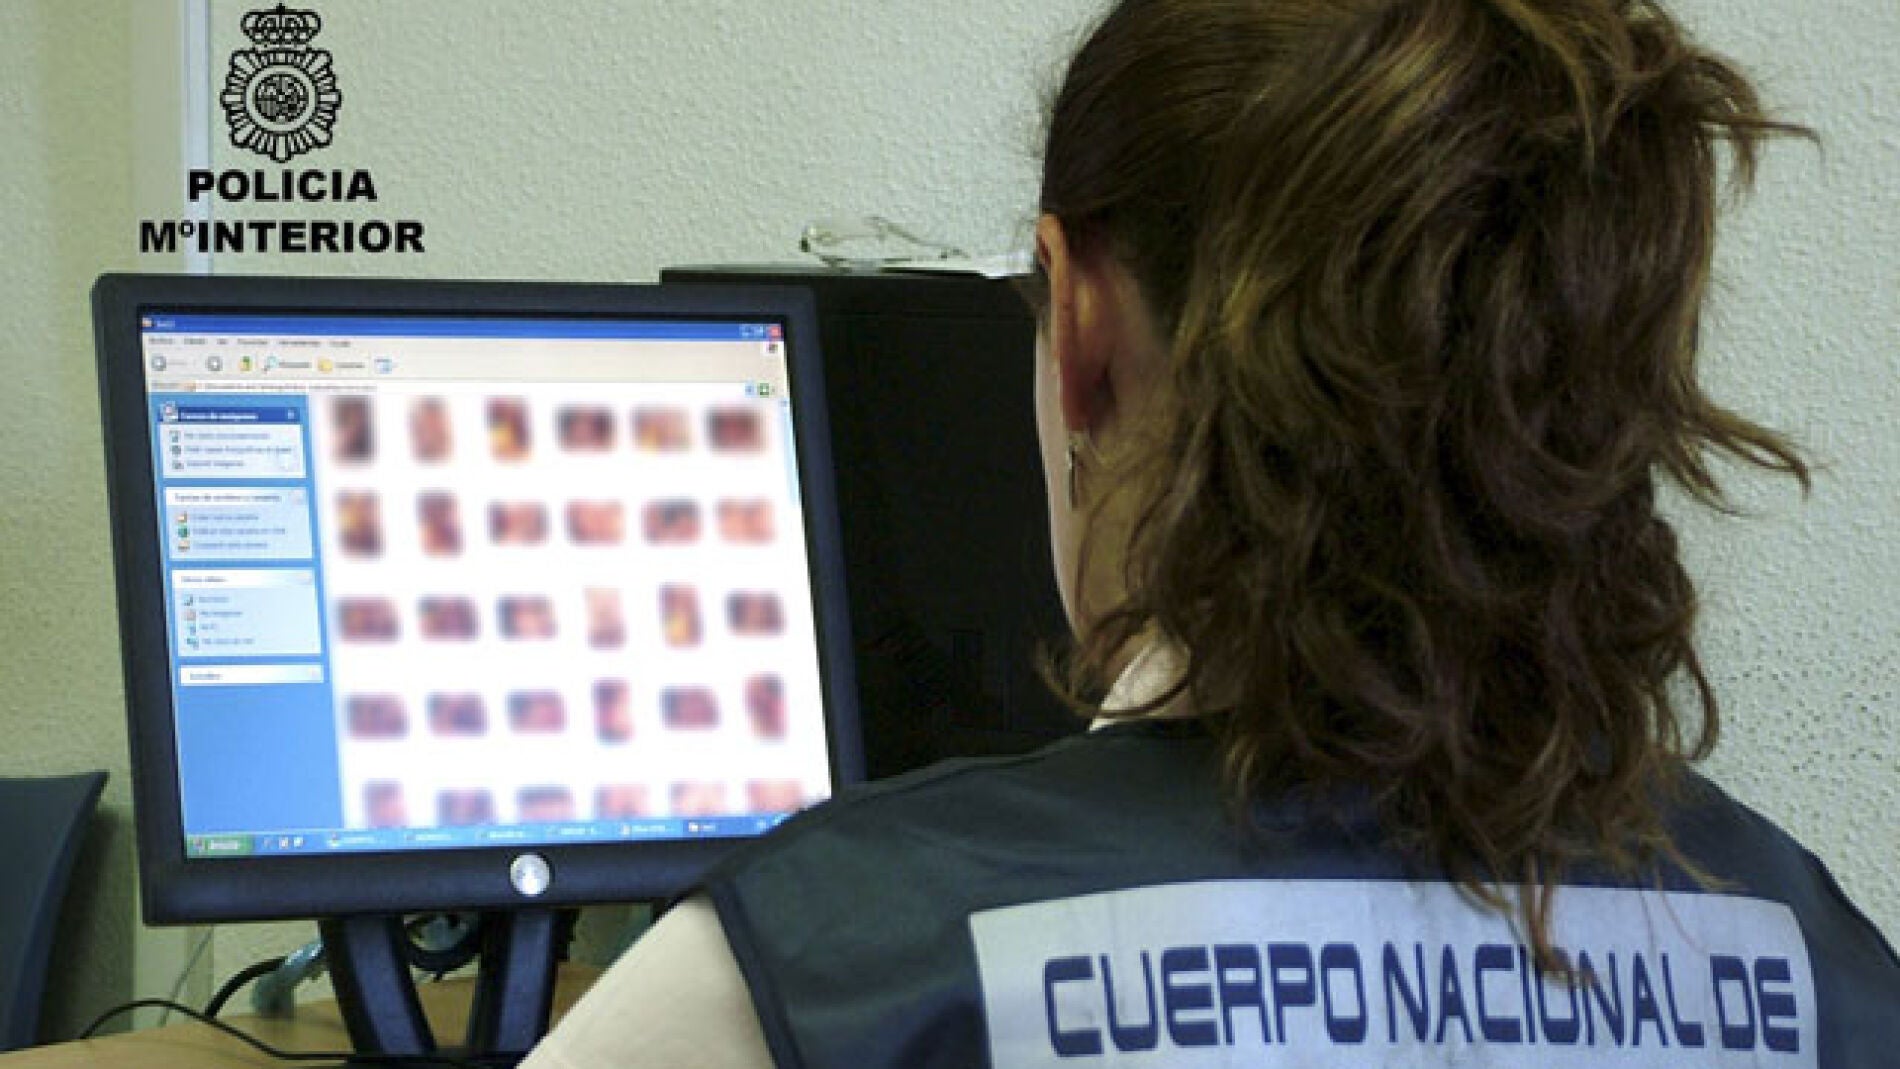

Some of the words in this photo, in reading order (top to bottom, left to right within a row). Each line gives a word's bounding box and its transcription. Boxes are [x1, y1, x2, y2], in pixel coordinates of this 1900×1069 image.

[1043, 942, 1367, 1057] CUERPO
[1382, 943, 1704, 1048] NACIONAL
[1710, 955, 1799, 1053] DE
